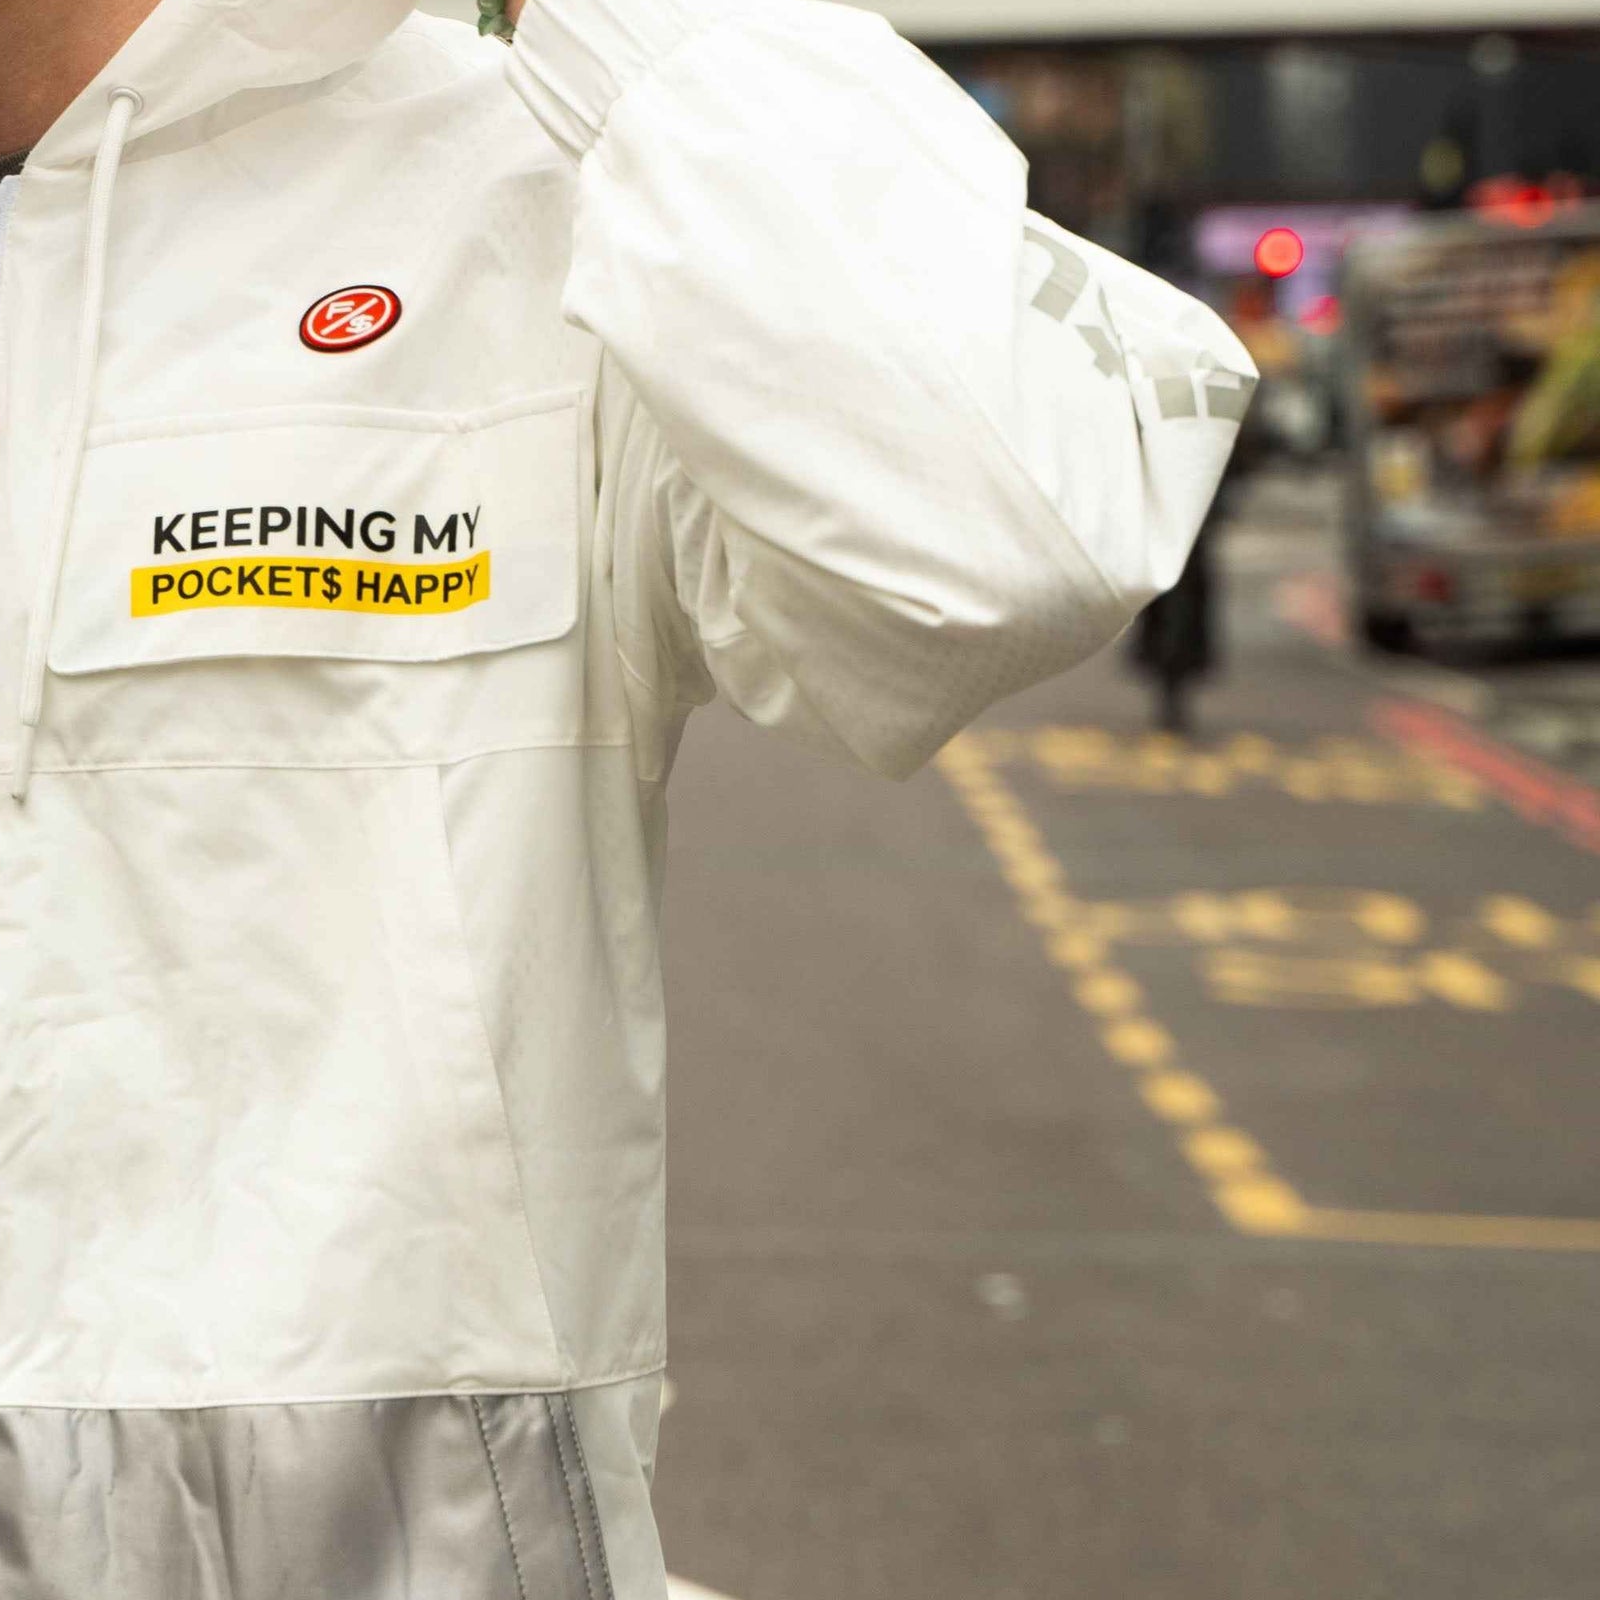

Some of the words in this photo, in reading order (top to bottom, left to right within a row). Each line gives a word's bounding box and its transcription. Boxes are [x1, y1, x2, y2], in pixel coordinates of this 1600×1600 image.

[152, 505, 397, 555] KEEPING
[413, 505, 481, 554] MY
[151, 565, 343, 605] POCKET$
[355, 563, 479, 605] HAPPY
